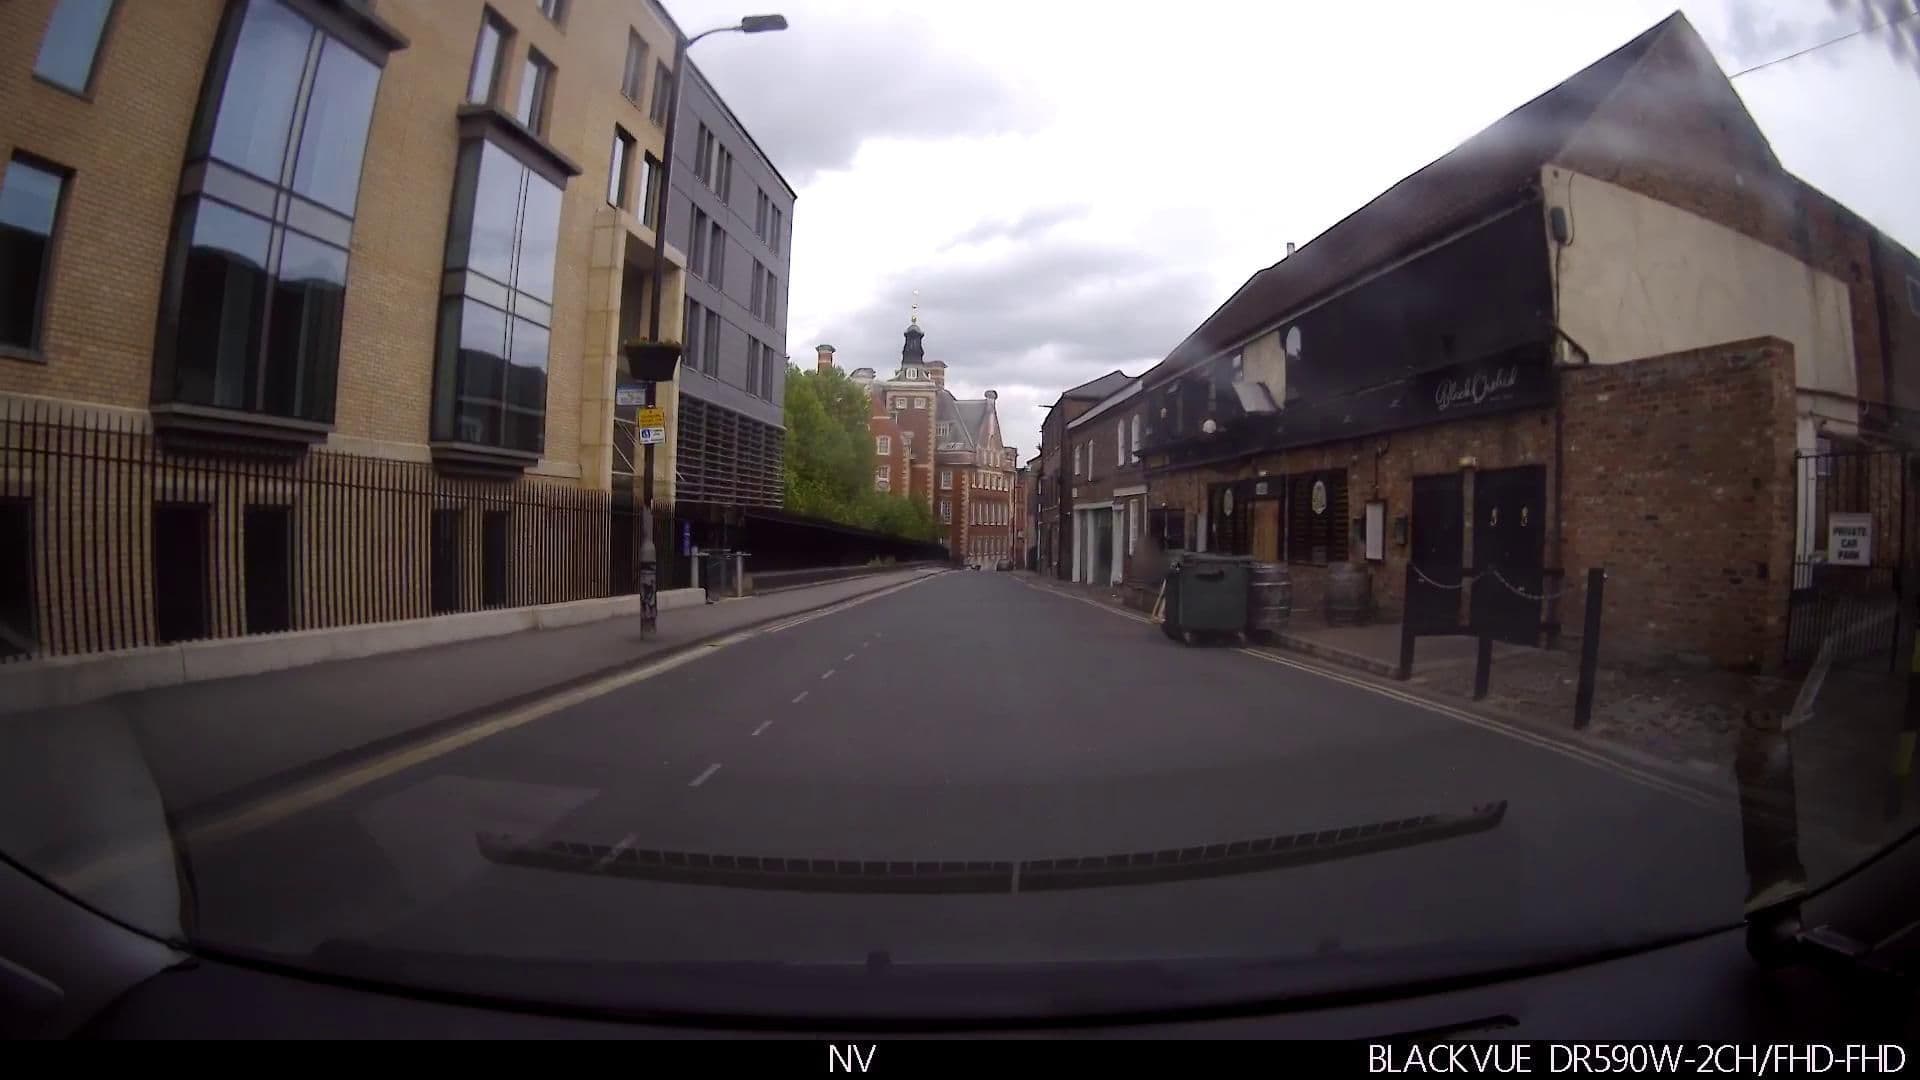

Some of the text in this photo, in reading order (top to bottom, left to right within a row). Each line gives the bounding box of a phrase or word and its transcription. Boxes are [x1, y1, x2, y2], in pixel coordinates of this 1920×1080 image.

[1435, 366, 1518, 411] Black Orchid
[1832, 526, 1867, 537] PRIVATE
[1841, 538, 1857, 549] CAR
[1838, 550, 1860, 560] PARK
